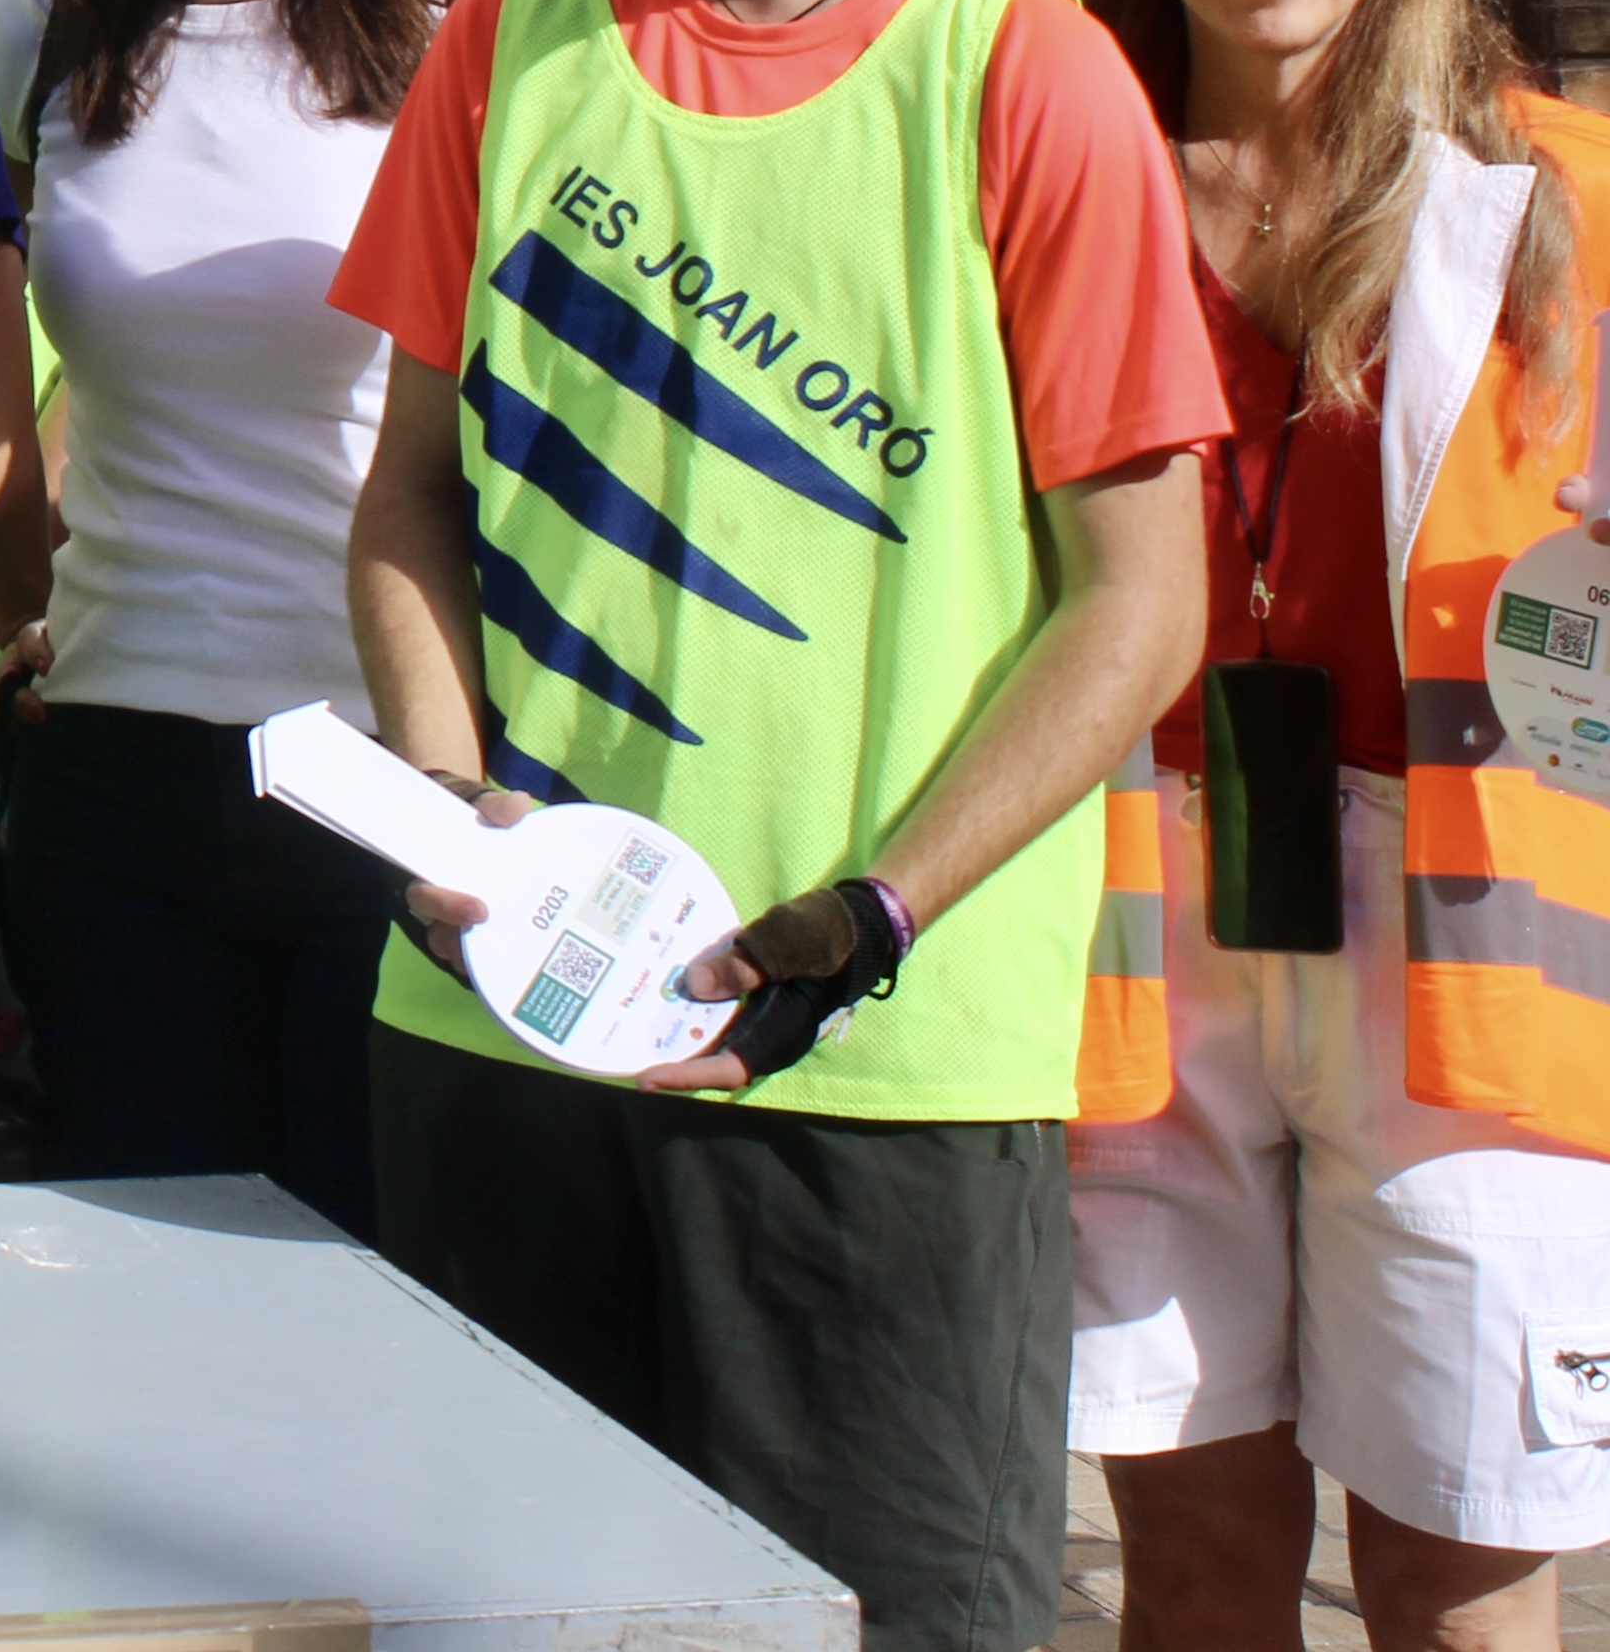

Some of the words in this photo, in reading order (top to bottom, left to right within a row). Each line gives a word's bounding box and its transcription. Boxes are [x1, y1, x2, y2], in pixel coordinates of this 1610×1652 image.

[548, 165, 639, 250] IES
[634, 240, 800, 371] JOAN
[794, 360, 935, 479] ORÓ
[532, 886, 569, 930] 0203
